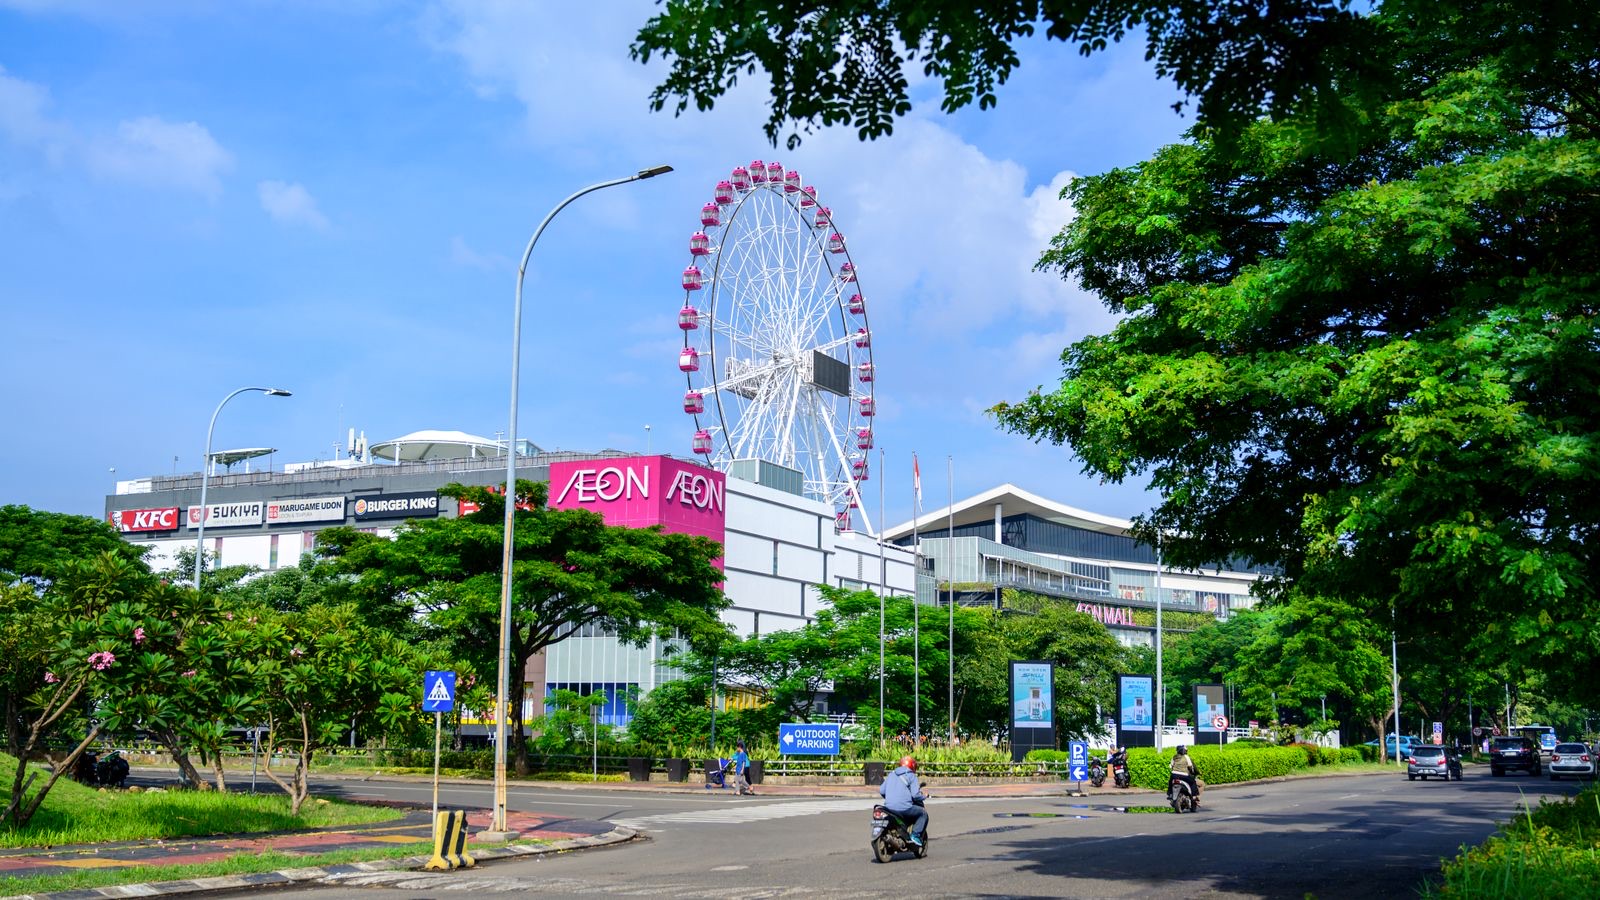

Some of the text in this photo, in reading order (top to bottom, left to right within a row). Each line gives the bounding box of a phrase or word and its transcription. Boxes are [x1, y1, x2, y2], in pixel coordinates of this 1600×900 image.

[213, 504, 259, 518] SUKIYA
[279, 502, 320, 512] MARUGAME
[321, 501, 342, 509] UDON
[367, 500, 408, 513] BURGER
[409, 496, 437, 510] KING
[132, 510, 174, 528] KFC
[1103, 606, 1137, 627] MALL
[1216, 717, 1224, 728] S
[795, 730, 836, 739] OUTDOOR
[797, 739, 834, 749] PARKING
[1072, 744, 1084, 759] P
